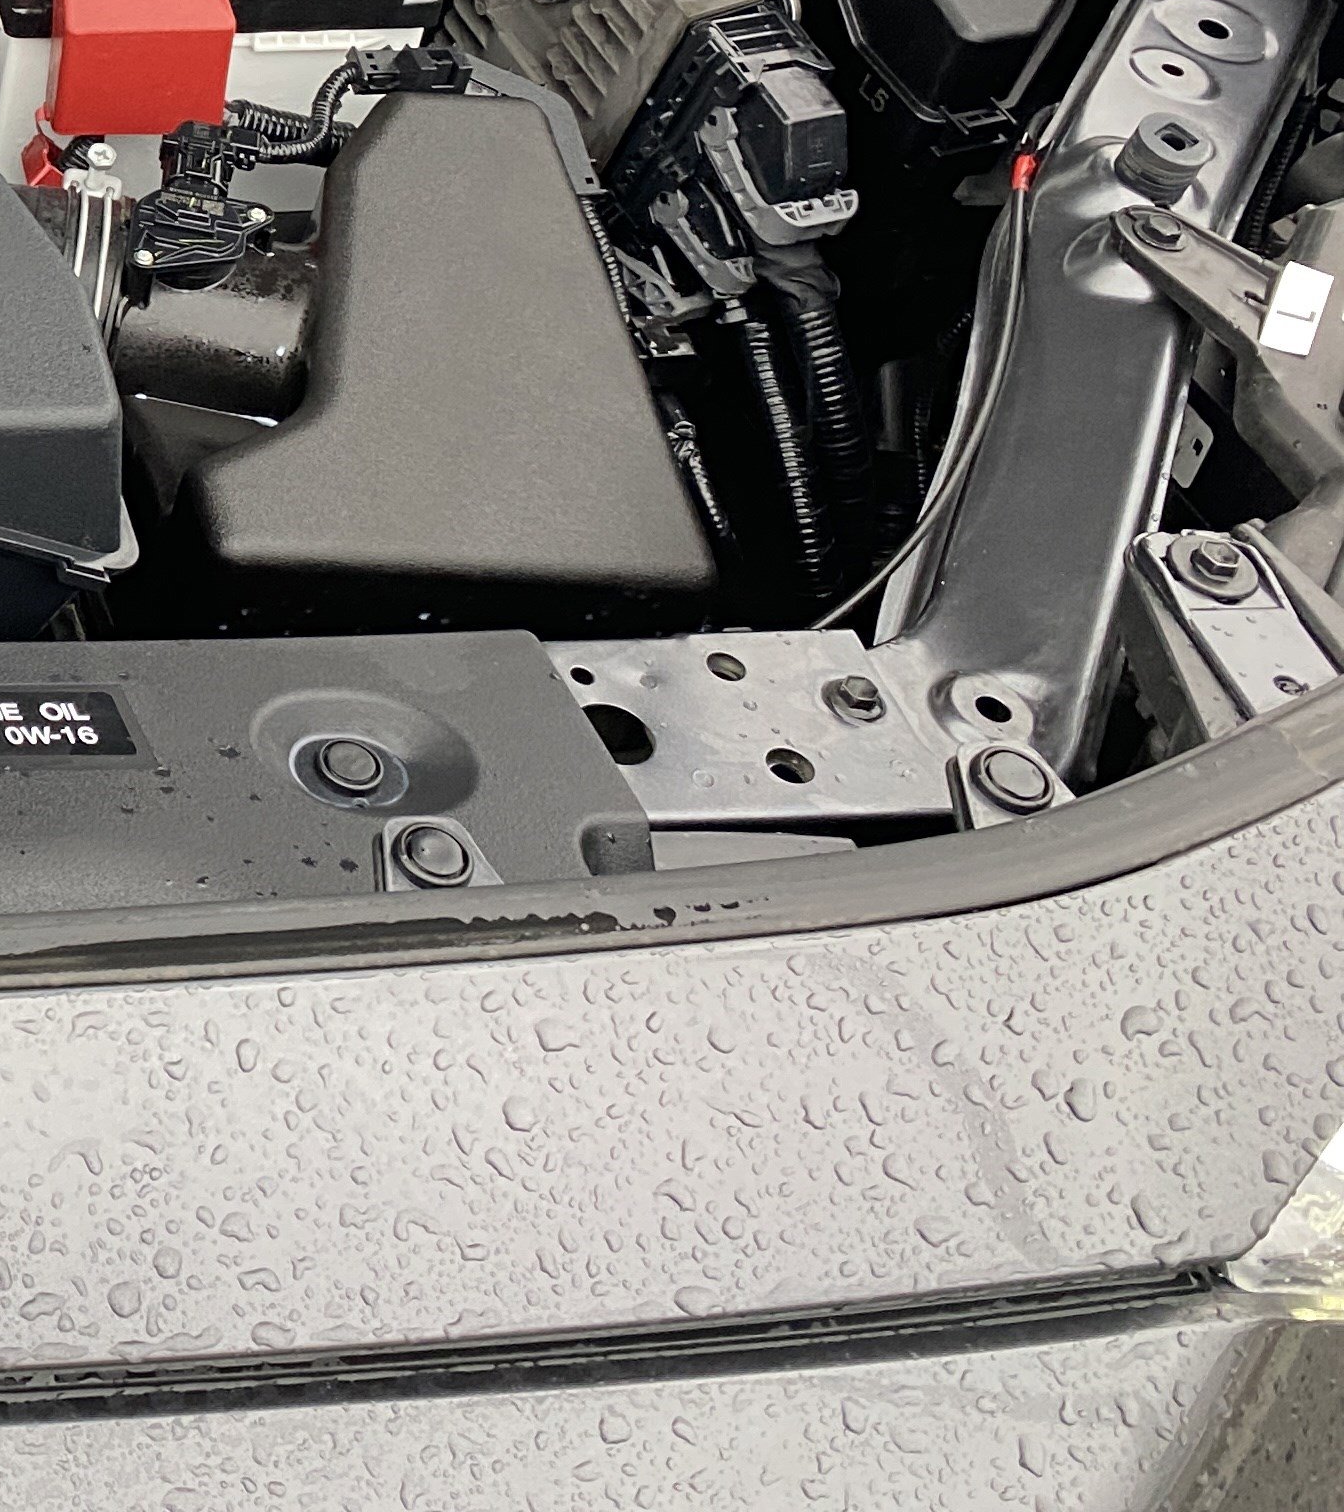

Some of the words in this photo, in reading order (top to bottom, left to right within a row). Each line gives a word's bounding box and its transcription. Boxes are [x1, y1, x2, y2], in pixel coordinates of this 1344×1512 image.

[1276, 310, 1317, 323] L
[38, 702, 91, 721] OIL
[4, 726, 99, 745] 0W-16
